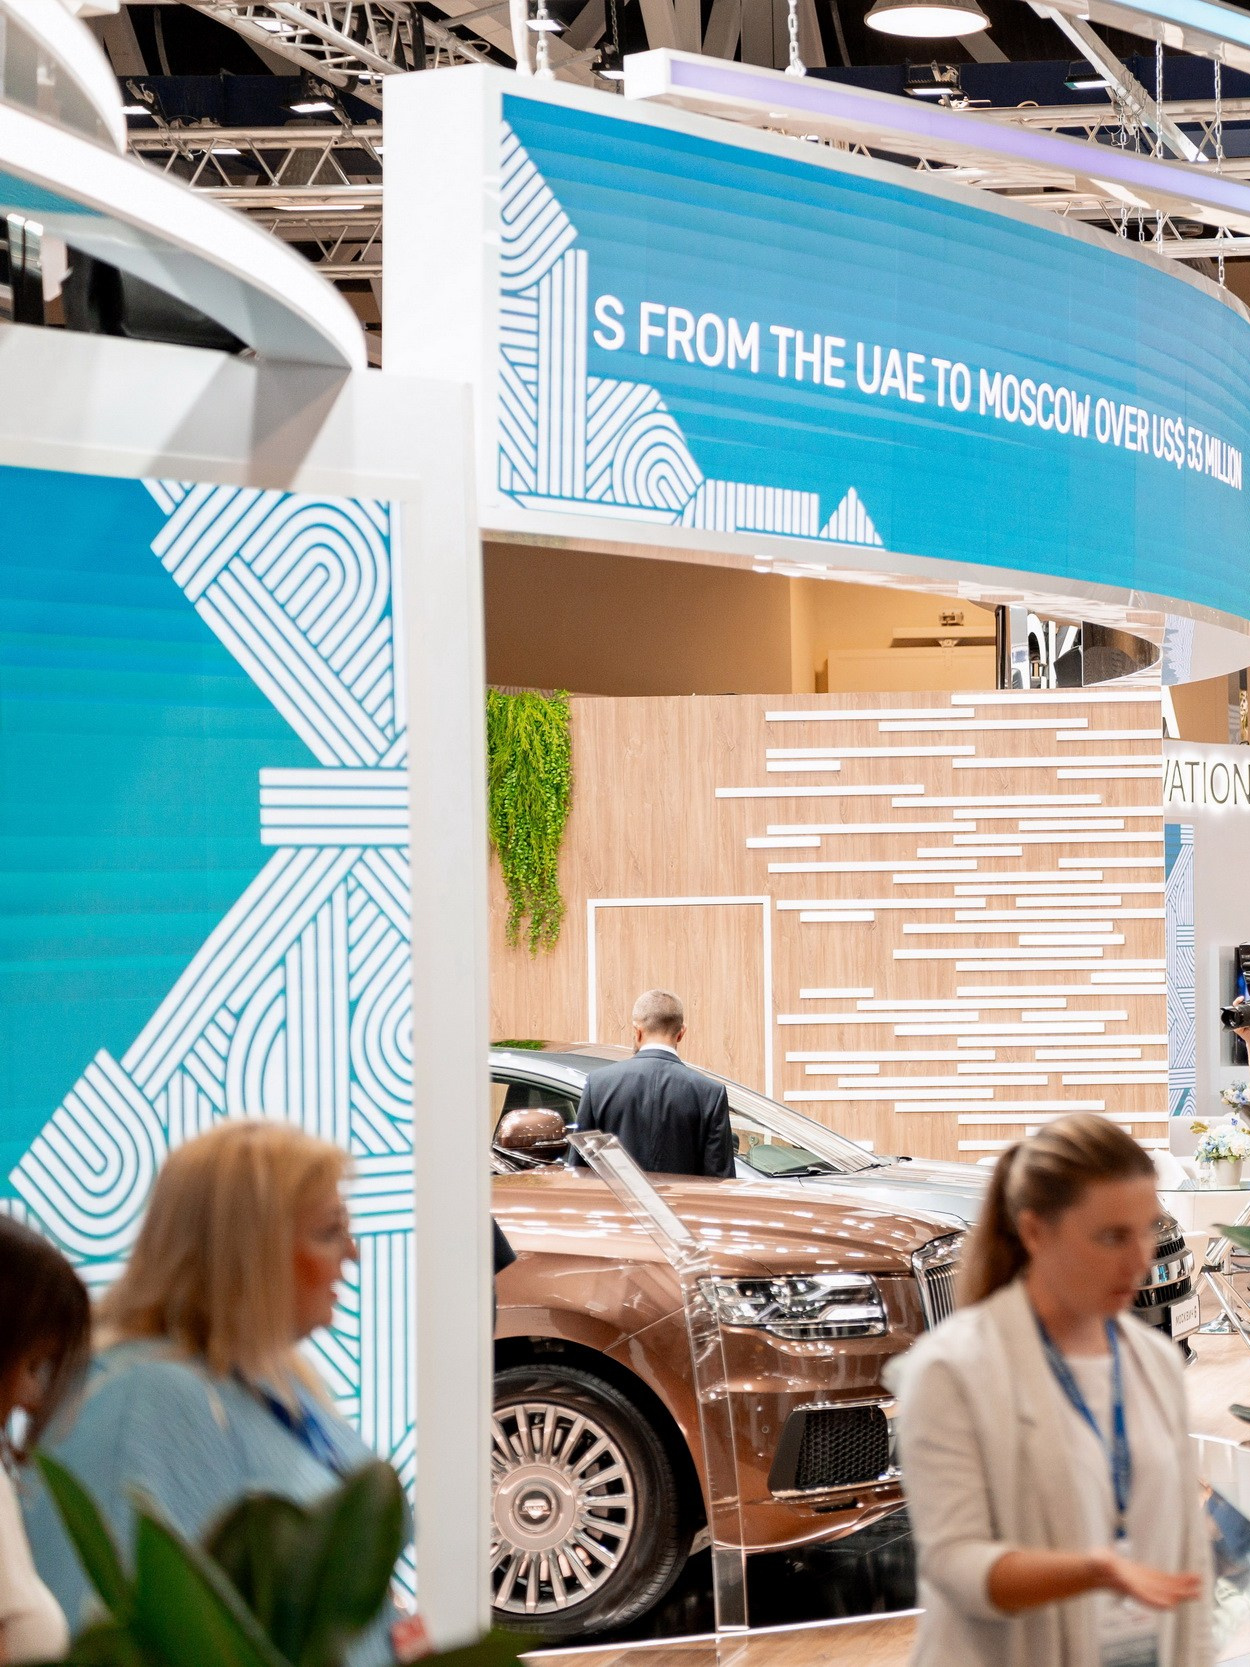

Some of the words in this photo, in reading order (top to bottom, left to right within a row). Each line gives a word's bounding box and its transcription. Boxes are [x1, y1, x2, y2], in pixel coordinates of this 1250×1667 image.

[592, 294, 626, 351] S
[639, 301, 760, 374] FROM
[769, 325, 846, 389] THE
[856, 341, 926, 404] UAE
[931, 357, 971, 412] TO
[979, 368, 1091, 438] MOSCOW
[1095, 397, 1149, 454] OVER
[1152, 413, 1186, 470] US$
[1187, 426, 1204, 472] 53
[1205, 433, 1243, 491] MILLION
